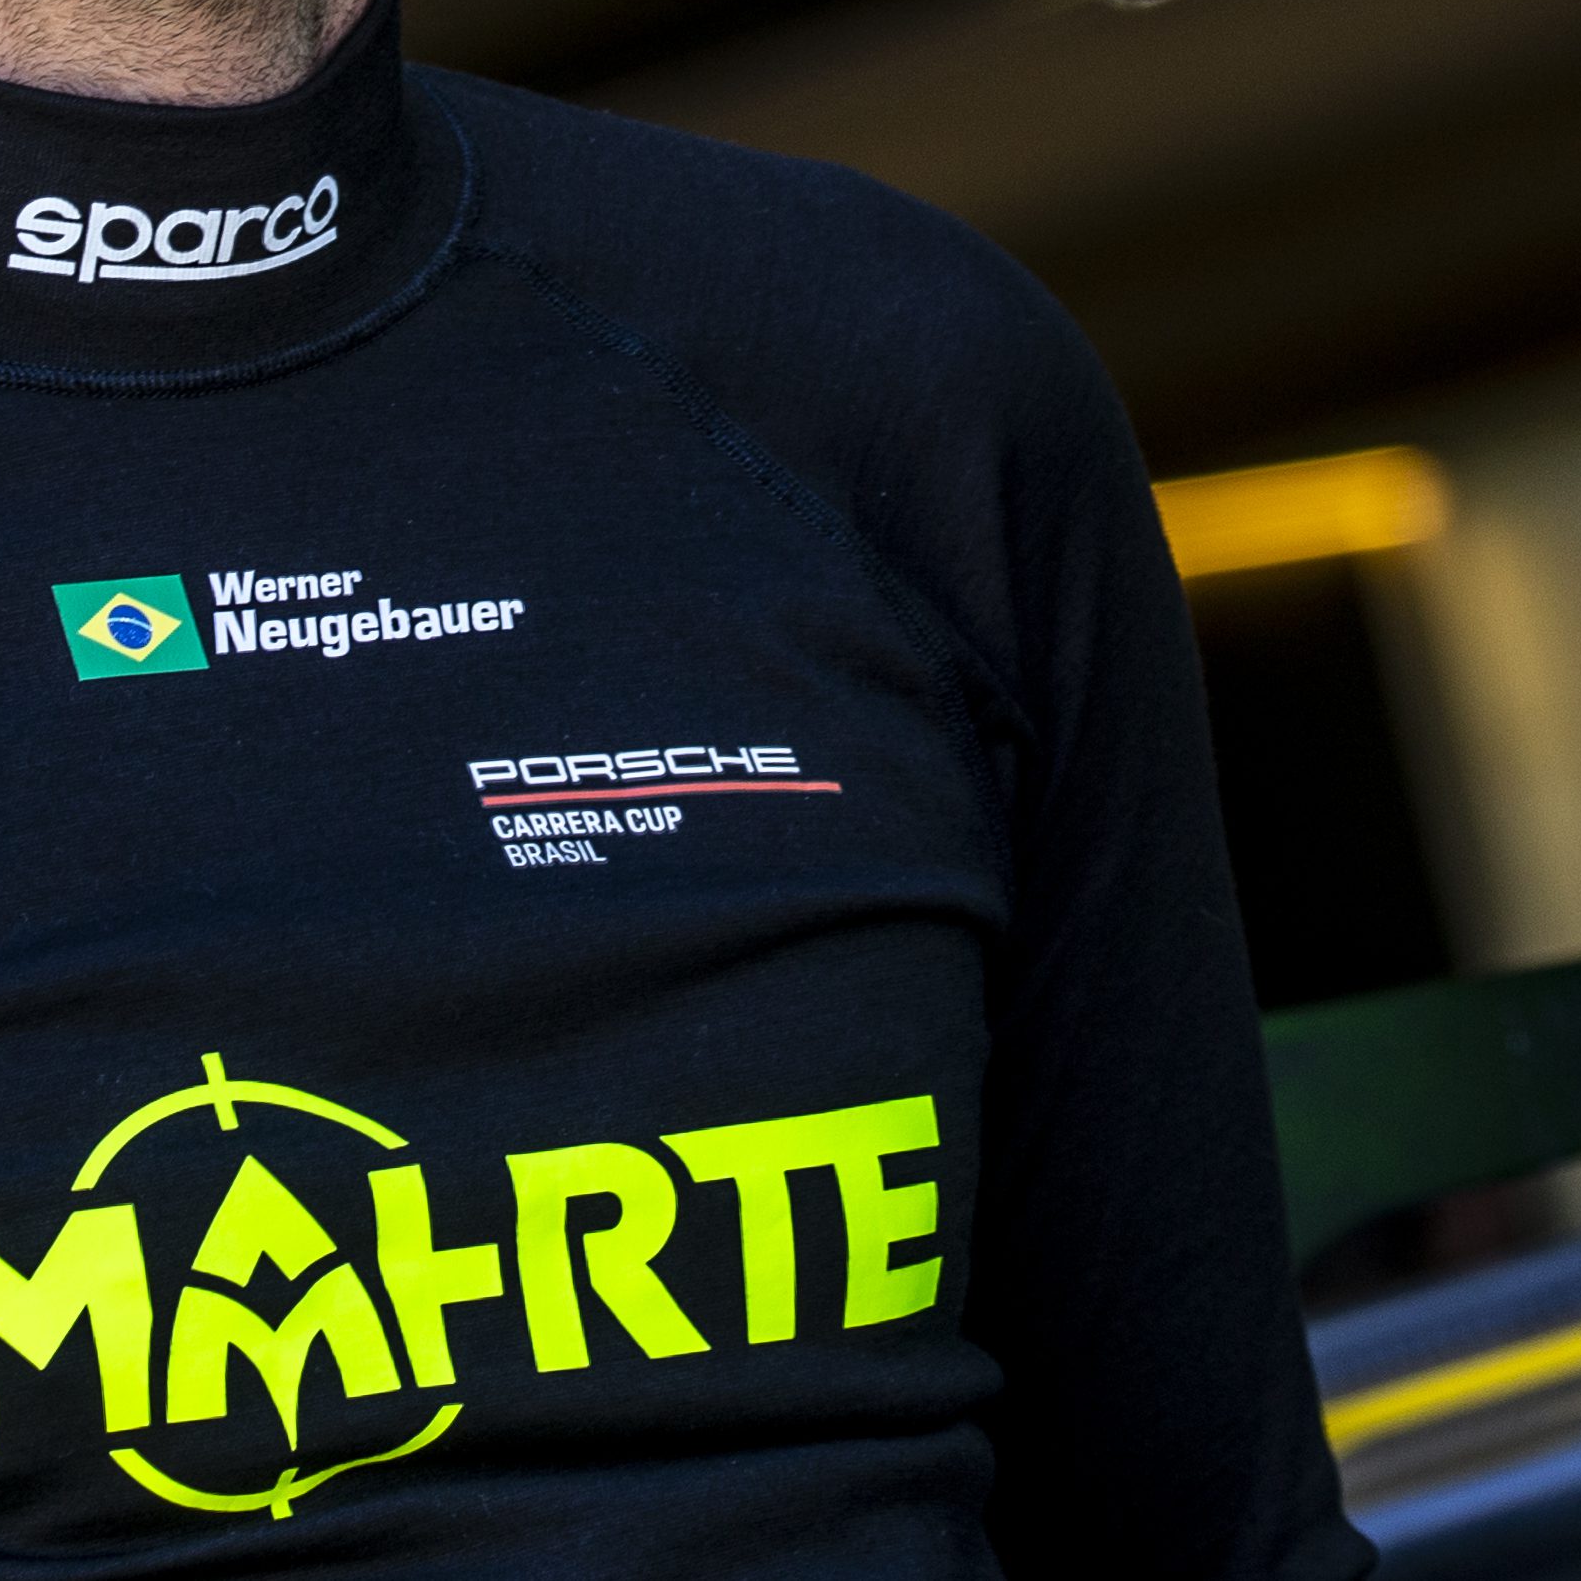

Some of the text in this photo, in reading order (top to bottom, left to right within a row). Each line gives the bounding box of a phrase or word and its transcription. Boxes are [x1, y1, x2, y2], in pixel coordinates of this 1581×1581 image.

[15, 174, 340, 283] sparco
[208, 569, 363, 607] Werner
[213, 597, 525, 658] Neugebauer
[466, 746, 802, 790] PORSCHE
[492, 805, 683, 840] CARRERA CUP
[504, 840, 608, 868] BRASIL
